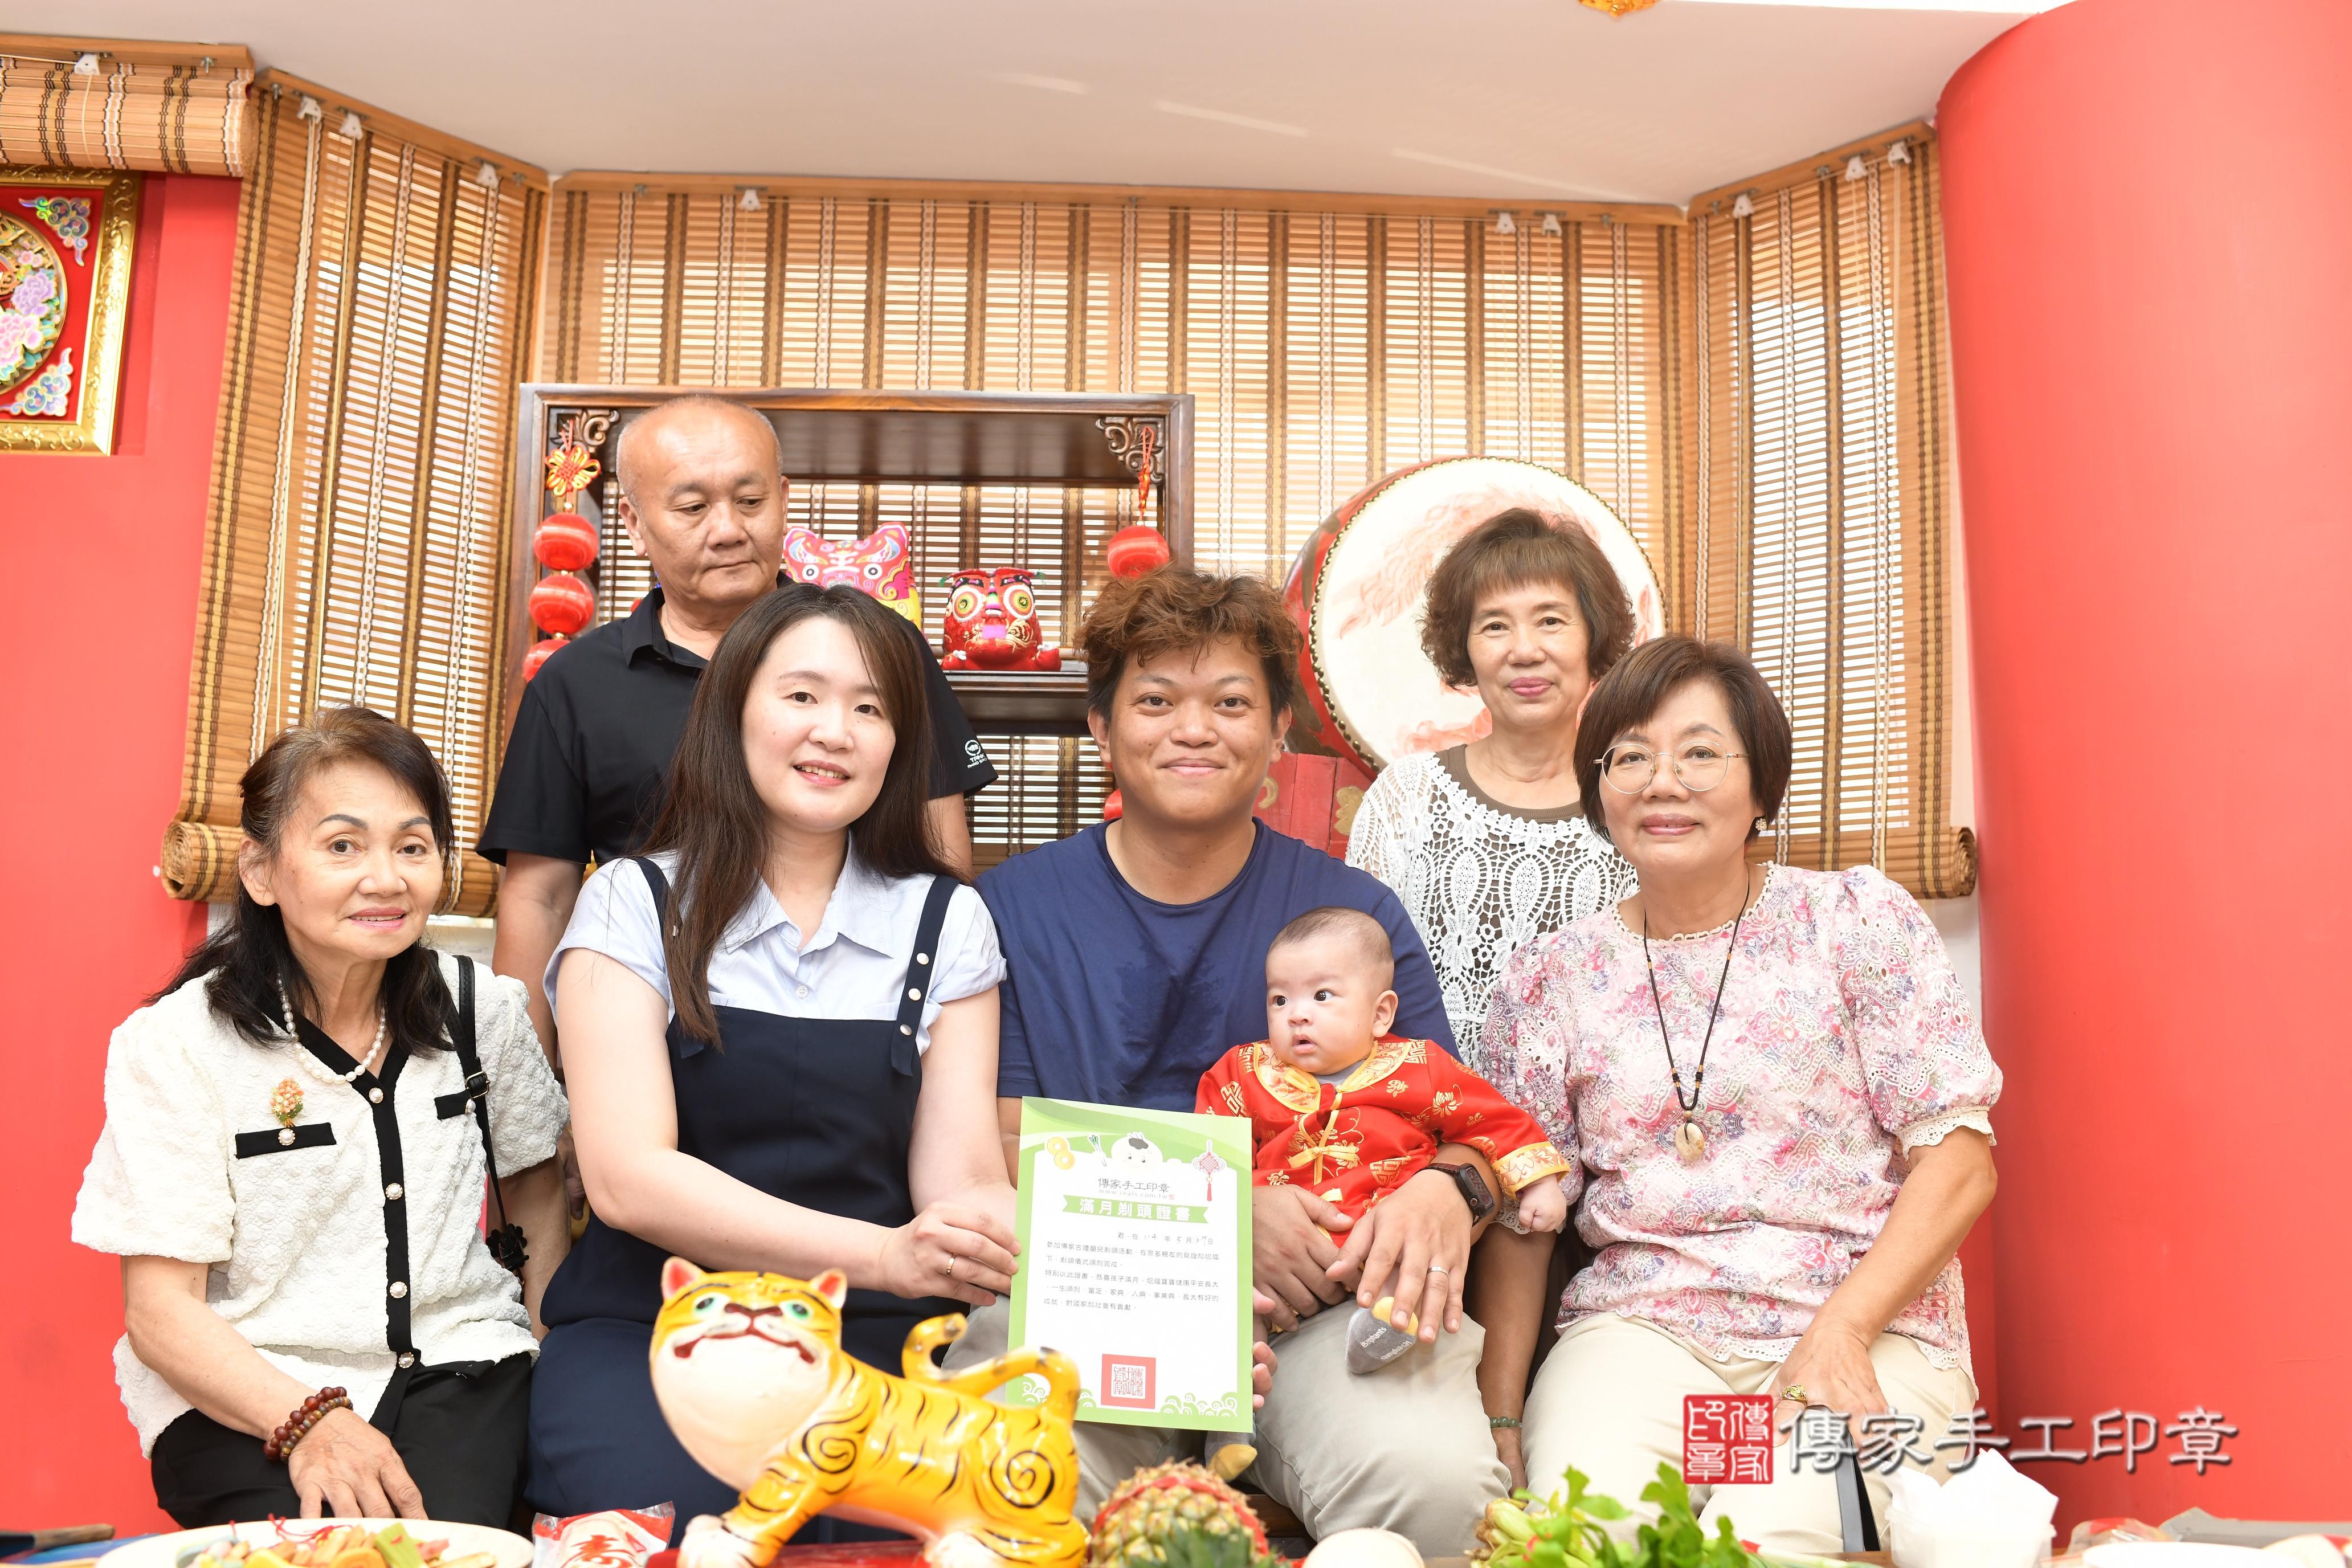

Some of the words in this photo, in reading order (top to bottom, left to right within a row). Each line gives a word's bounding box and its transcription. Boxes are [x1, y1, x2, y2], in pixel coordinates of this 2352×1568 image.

[1098, 1178, 1170, 1193] 傳家手工印章
[1099, 1189, 1167, 1199] www.seals.com.tw
[1079, 1197, 1191, 1222] 滿月剃頭證書
